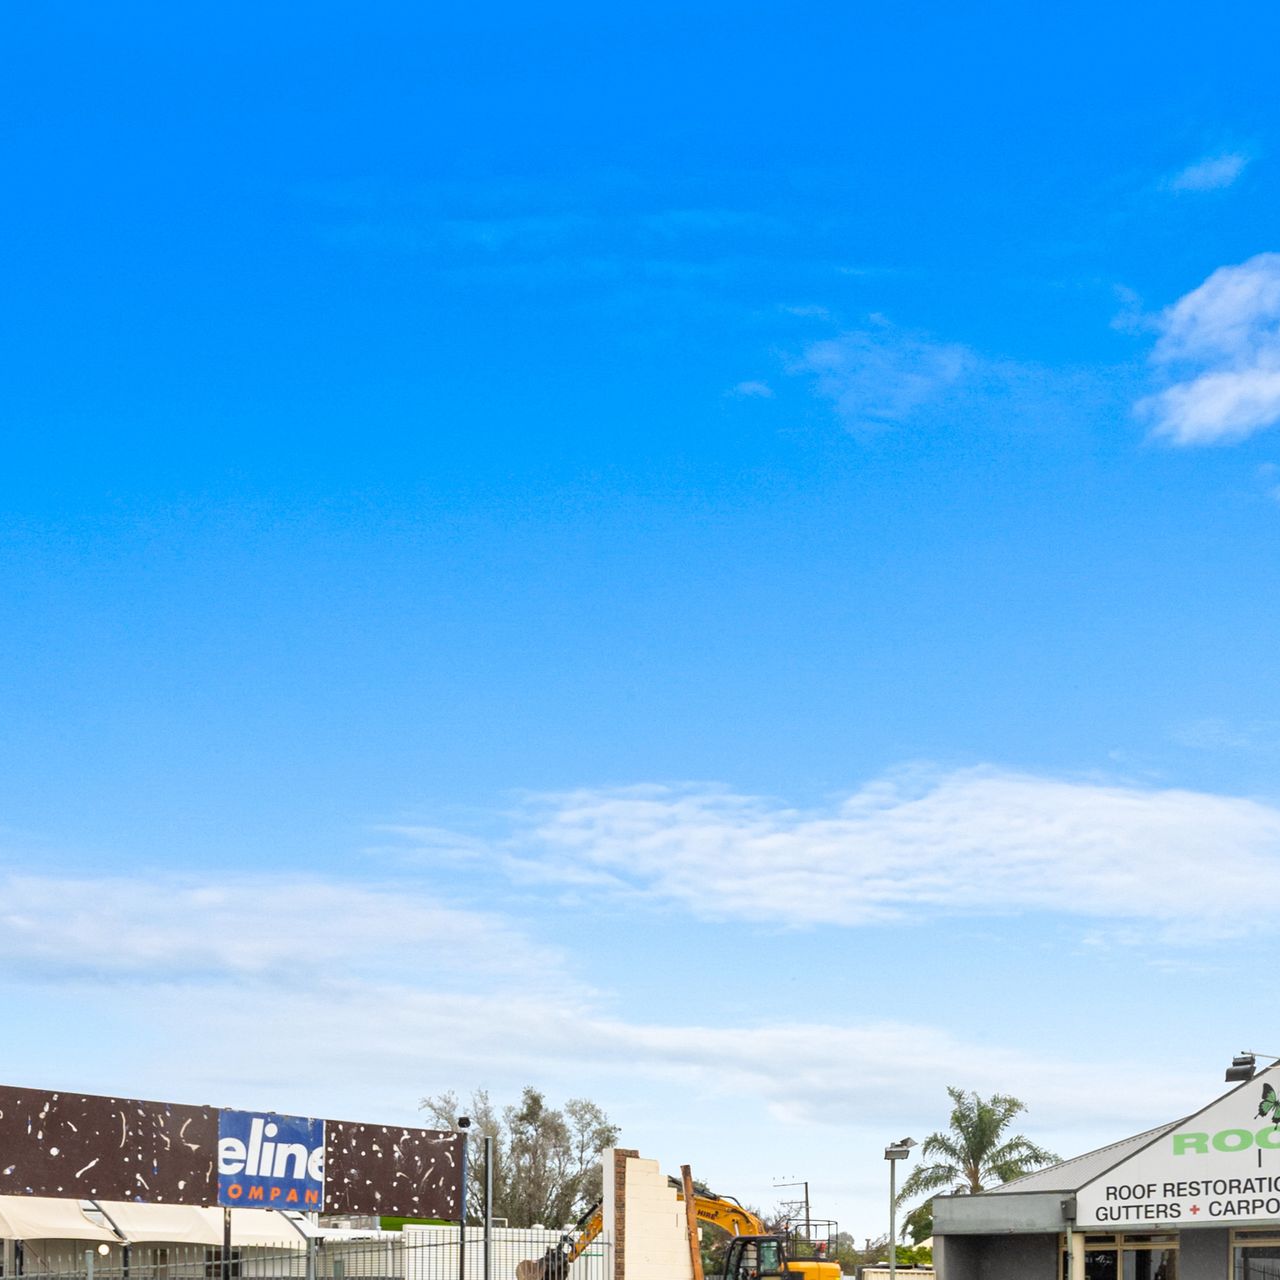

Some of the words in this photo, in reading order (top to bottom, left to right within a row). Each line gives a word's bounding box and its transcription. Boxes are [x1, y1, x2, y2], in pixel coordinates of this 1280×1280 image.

[218, 1184, 319, 1204] OMPAN
[1106, 1183, 1157, 1201] ROOF
[1095, 1203, 1182, 1221] GUTTERS
